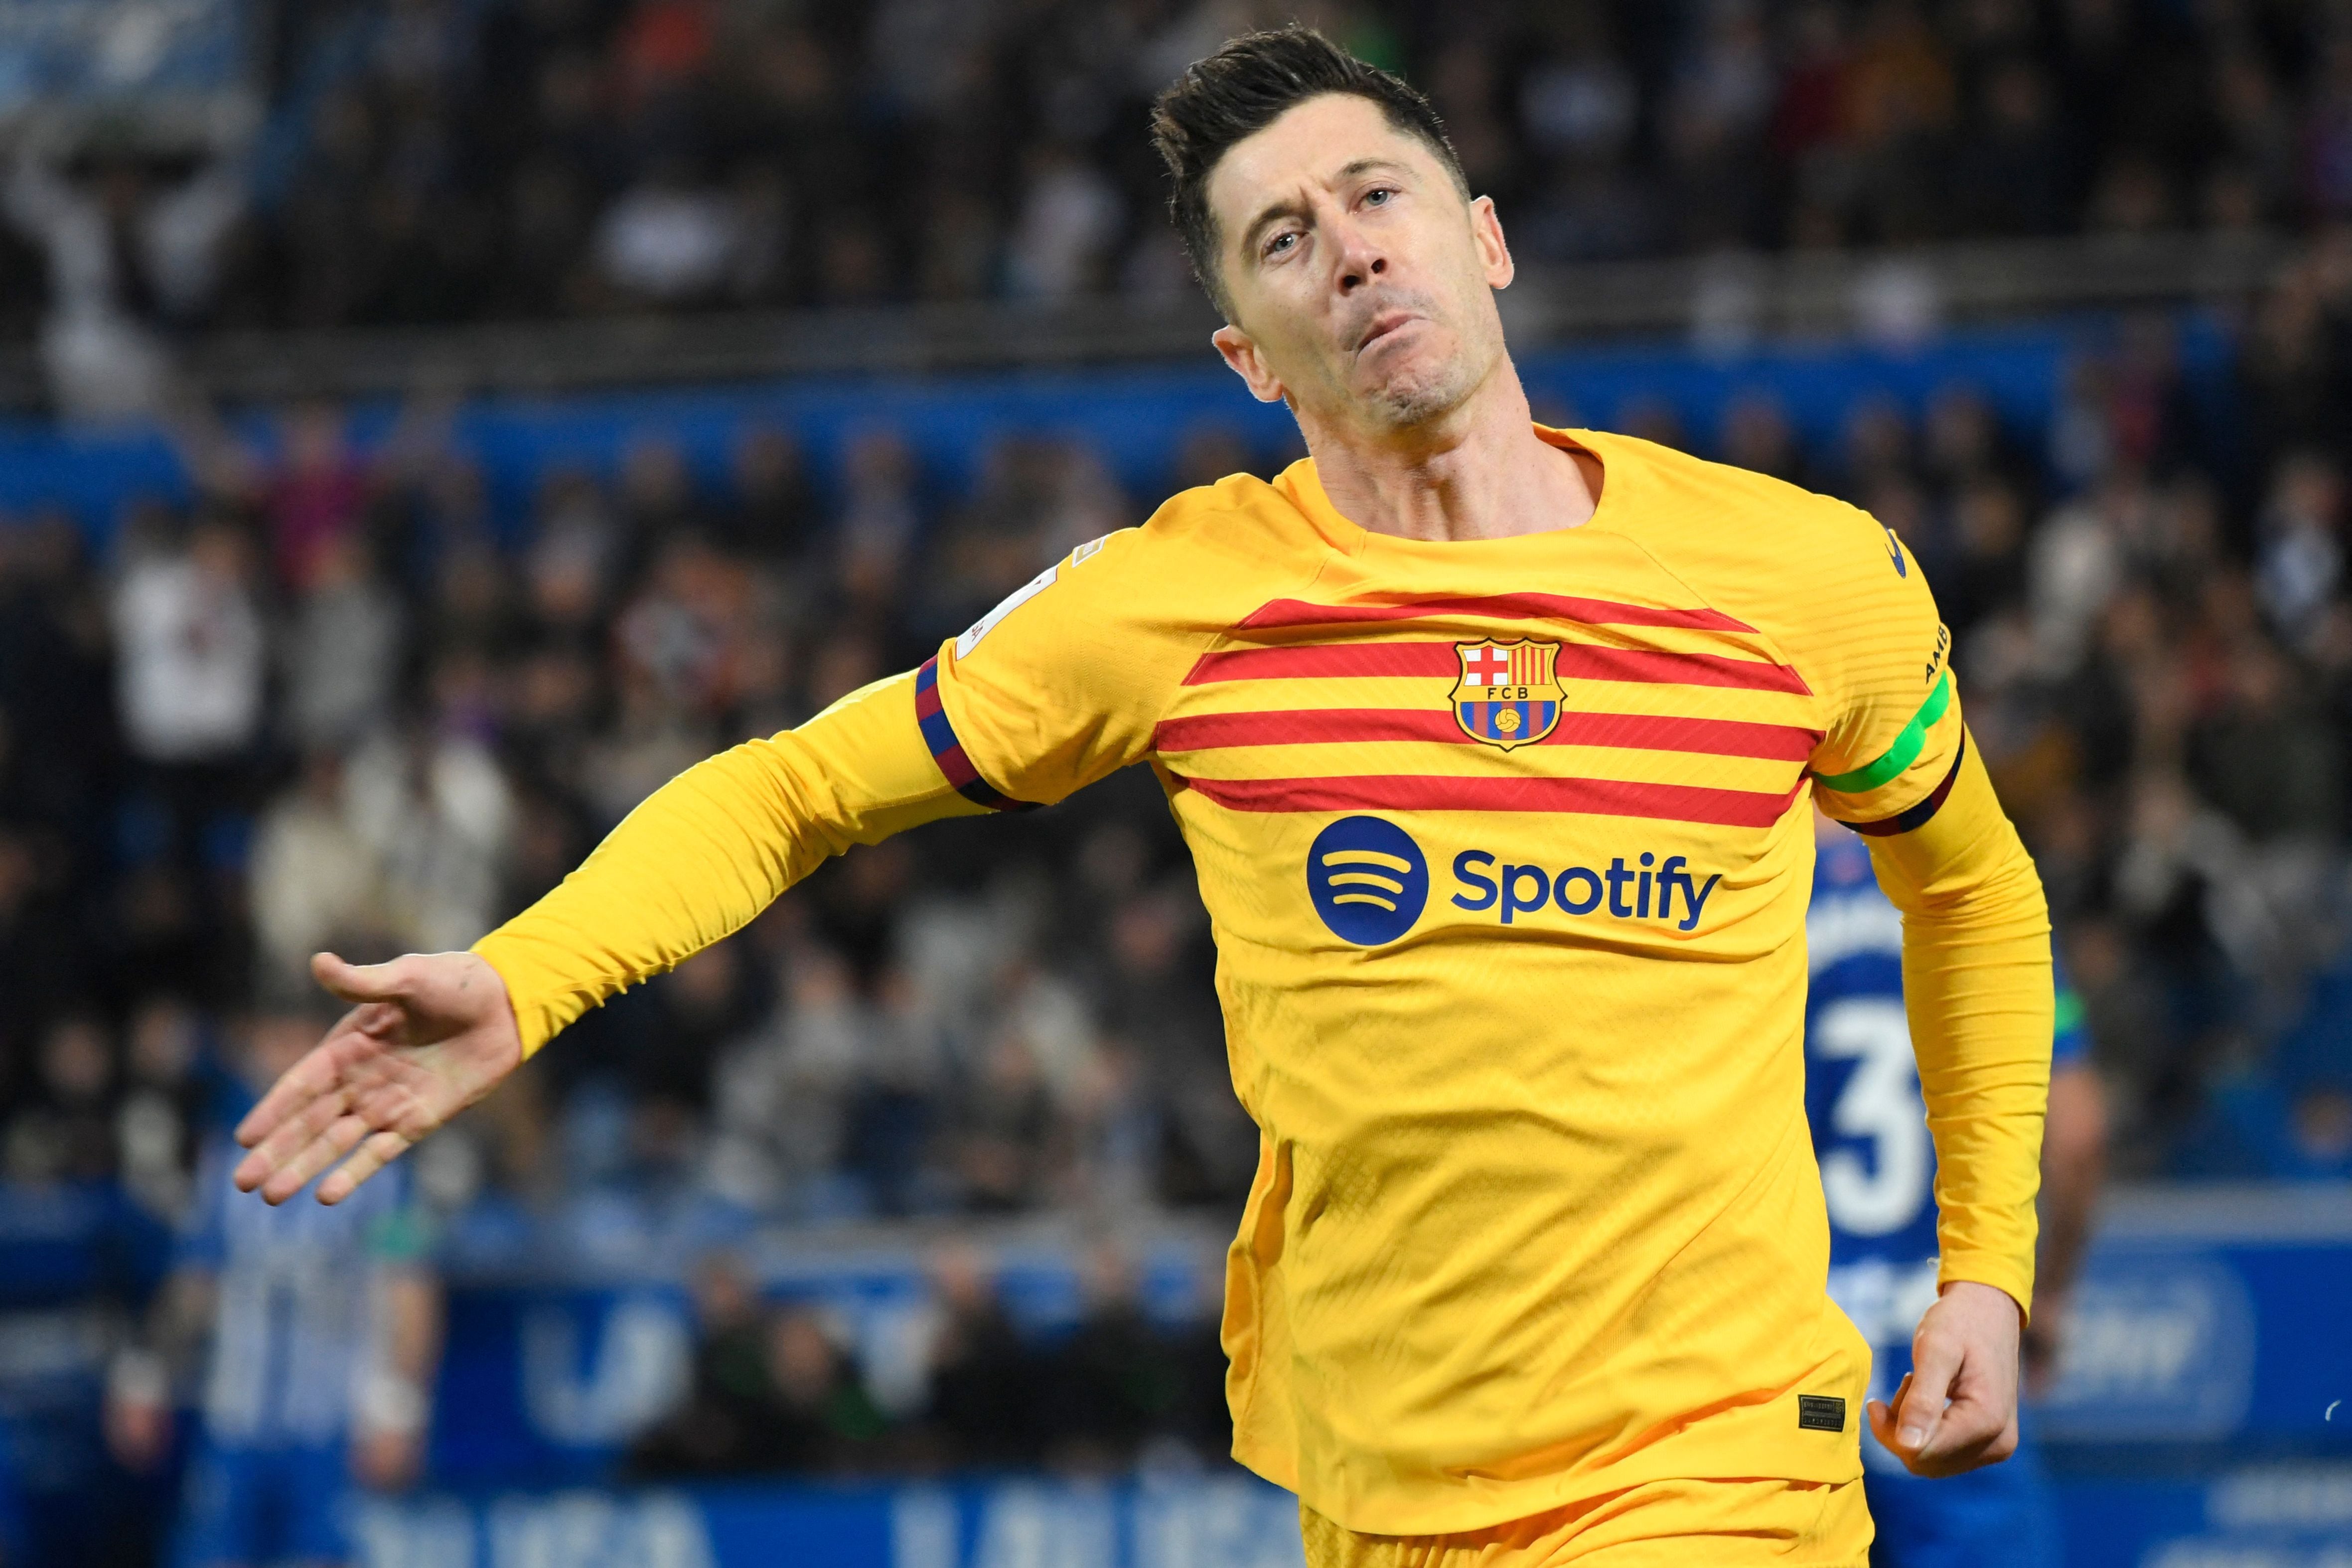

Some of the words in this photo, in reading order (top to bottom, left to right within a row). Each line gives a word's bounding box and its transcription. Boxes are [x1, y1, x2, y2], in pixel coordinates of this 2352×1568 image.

[1487, 687, 1528, 700] FCB
[1451, 849, 1723, 931] Spotify
[1818, 996, 1927, 1237] 3
